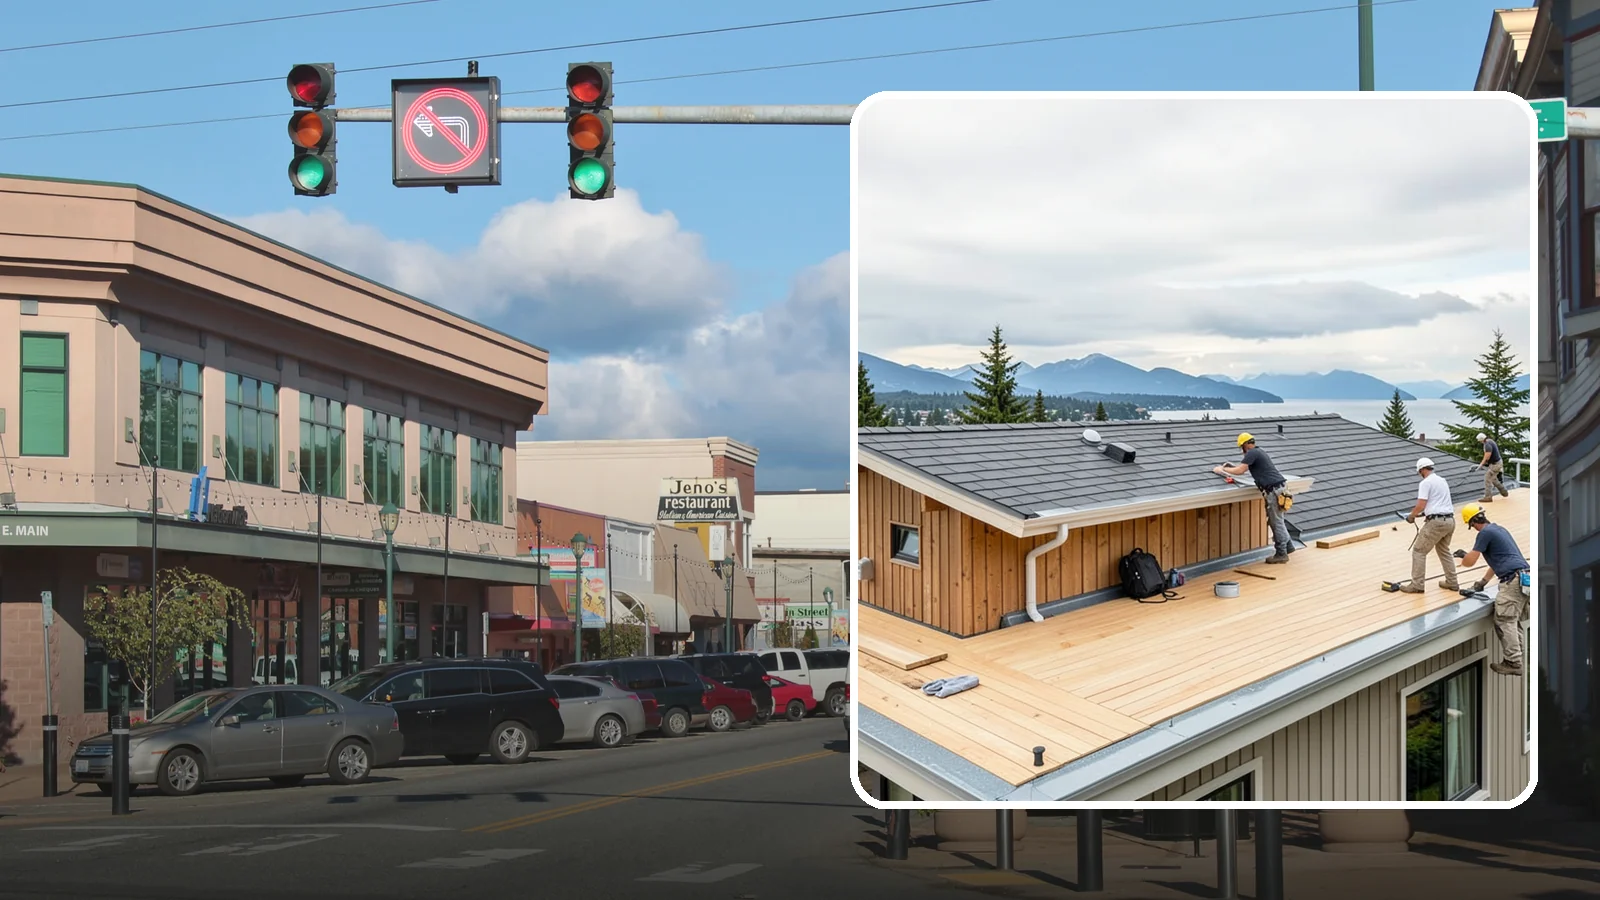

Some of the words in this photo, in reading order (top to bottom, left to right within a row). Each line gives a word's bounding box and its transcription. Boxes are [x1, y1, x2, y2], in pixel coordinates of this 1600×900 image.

[670, 480, 727, 494] Jeno's
[665, 496, 731, 509] restaurant
[658, 509, 681, 519] Italian
[686, 509, 715, 519] American
[715, 509, 736, 519] Cuisine
[2, 525, 13, 536] E.
[15, 525, 49, 536] MAIN
[797, 608, 828, 617] Street
